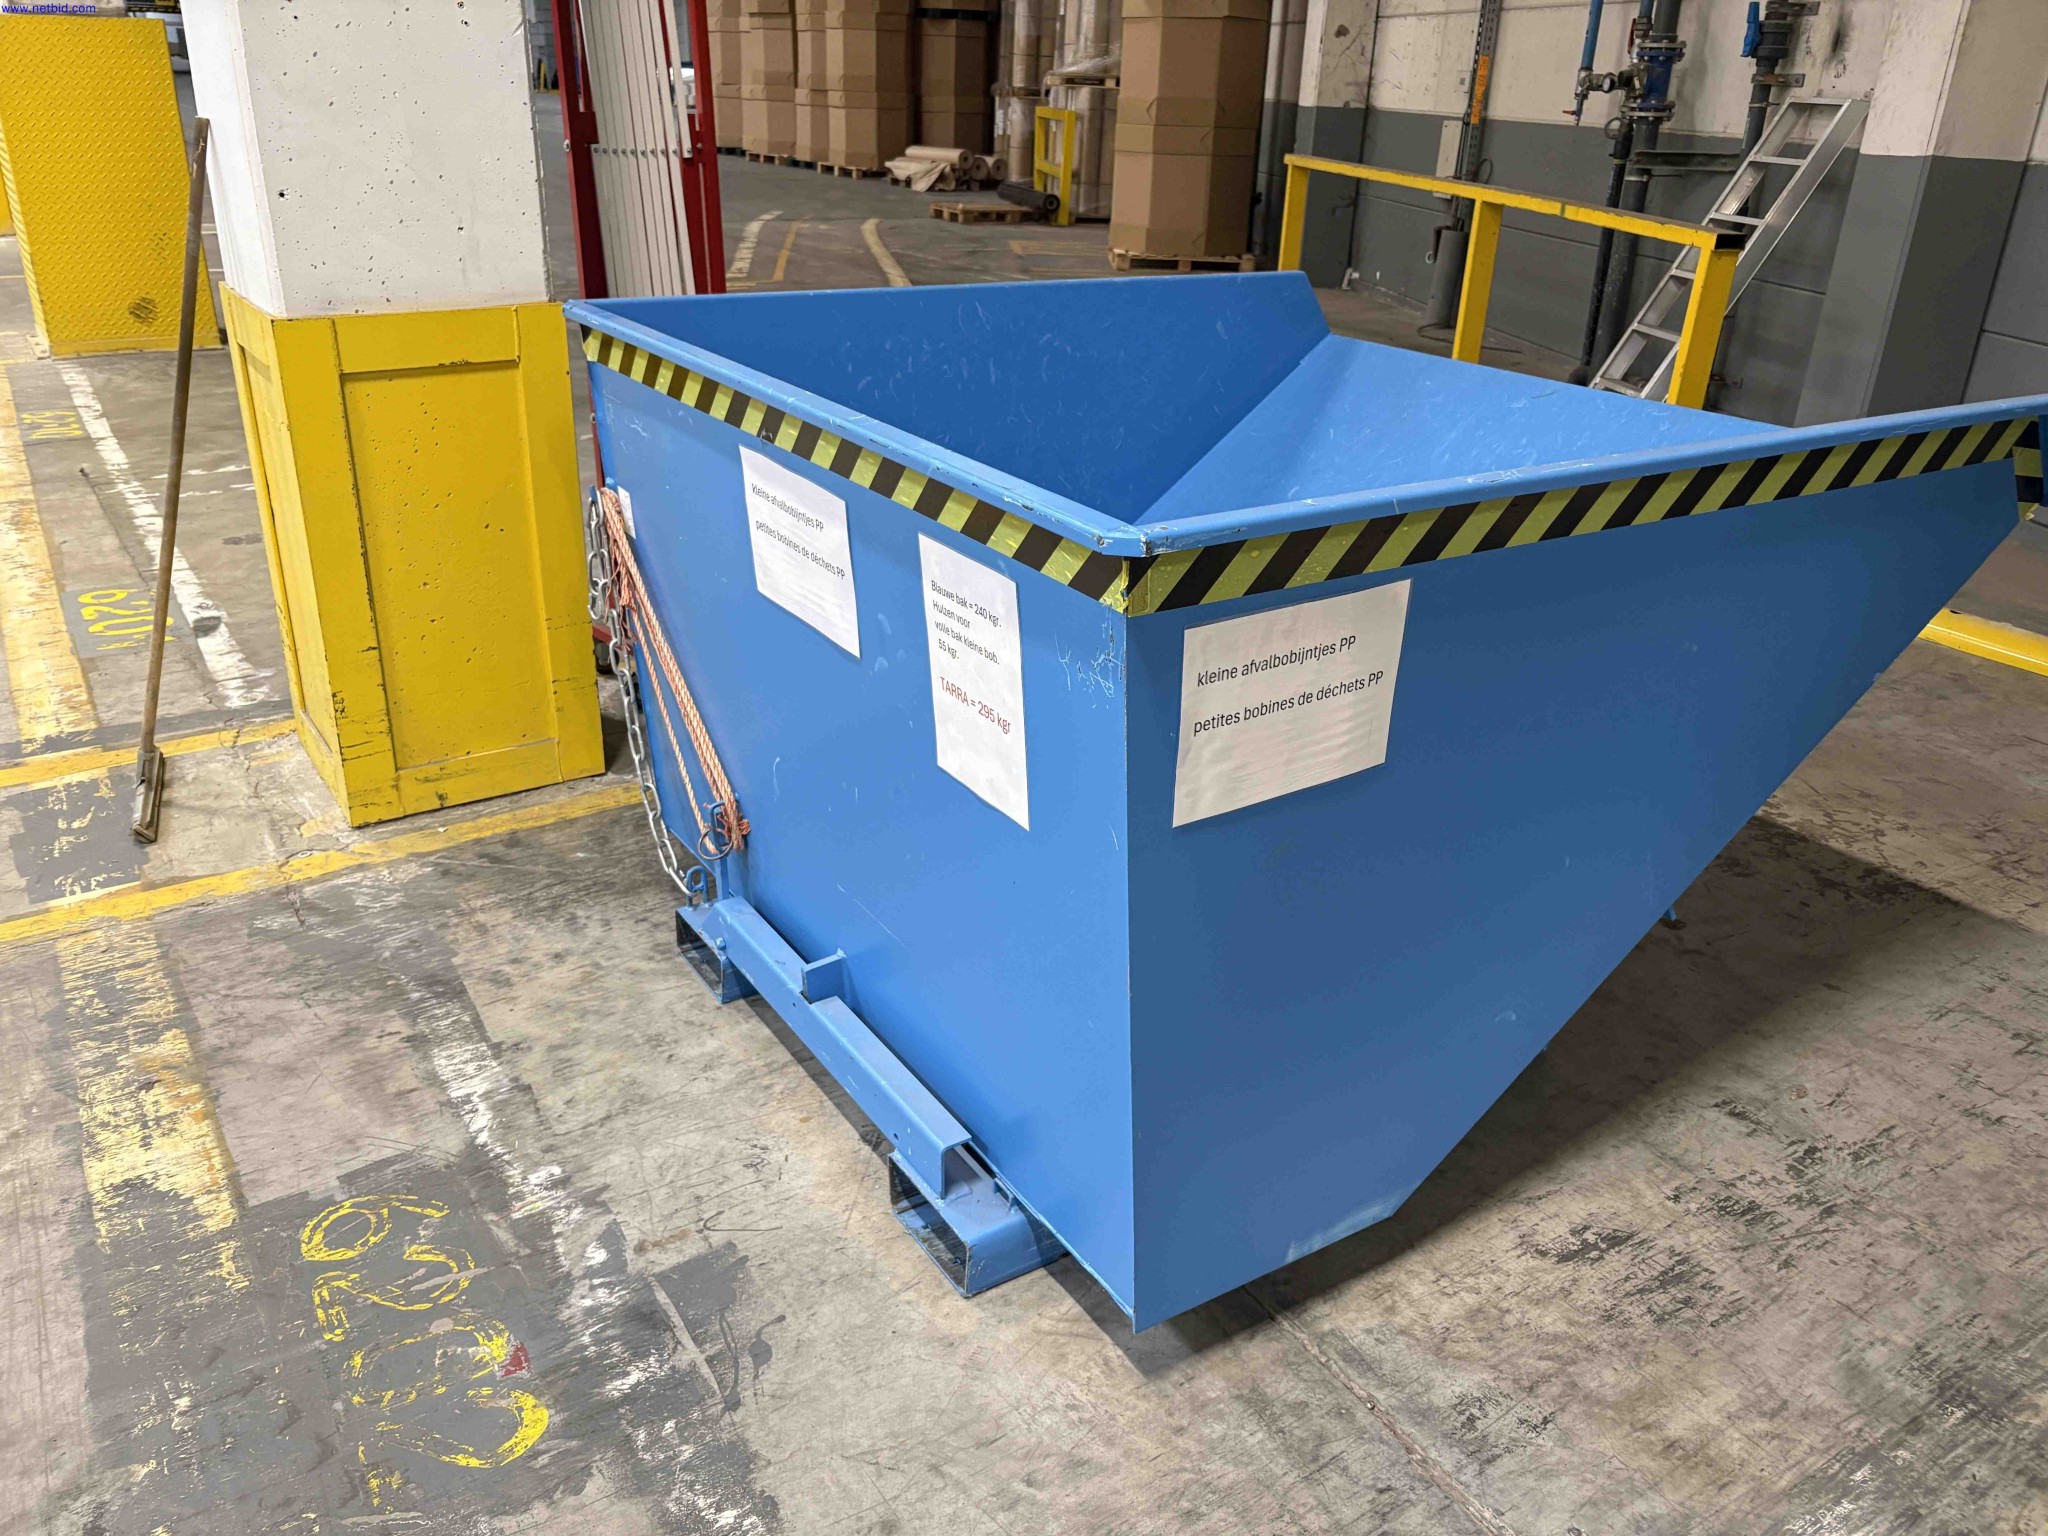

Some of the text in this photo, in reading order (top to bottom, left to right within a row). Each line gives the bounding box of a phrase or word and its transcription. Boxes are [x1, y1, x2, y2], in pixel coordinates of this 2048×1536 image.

[751, 482, 770, 502] kleine
[815, 517, 824, 532] PP
[755, 520, 845, 580] petites bobines de déchets PP
[931, 579, 955, 604] Blauwe
[955, 591, 968, 610] bak
[974, 602, 988, 620] 240
[988, 609, 1002, 628] kgr.
[932, 599, 971, 629] Hulzen voor
[934, 620, 1000, 665] volle bak kleine bob.
[938, 639, 960, 660] 55 kgr.
[1197, 635, 1356, 687] kleine afvalbobijntjes PP
[939, 675, 970, 708] TARRA
[977, 700, 996, 724] 295
[996, 710, 1011, 735] kgr
[1193, 670, 1384, 737] petites bobines de déchets PP
